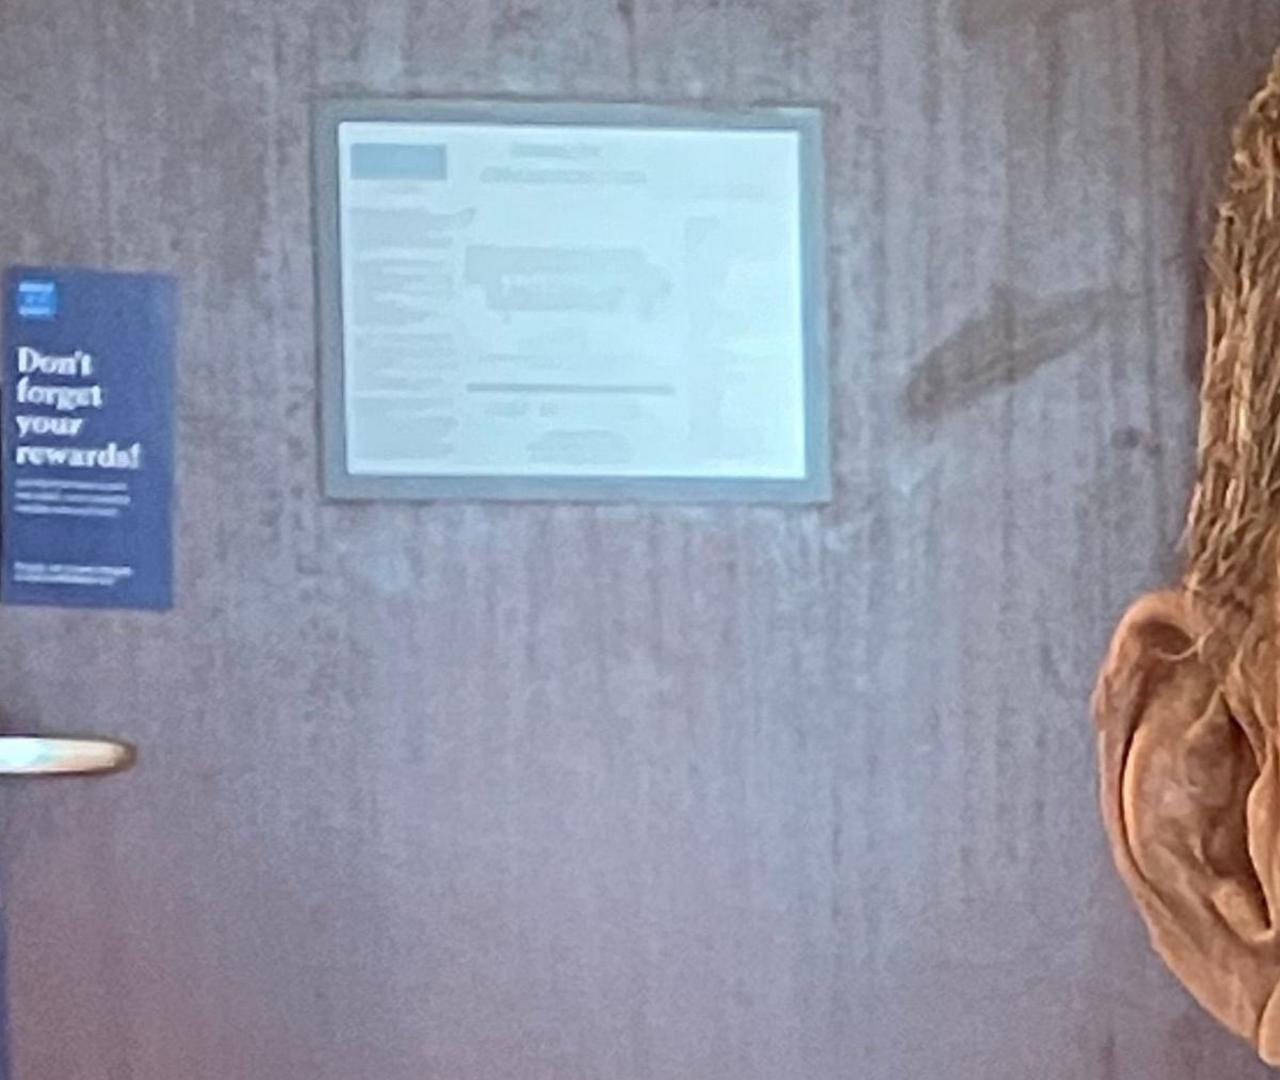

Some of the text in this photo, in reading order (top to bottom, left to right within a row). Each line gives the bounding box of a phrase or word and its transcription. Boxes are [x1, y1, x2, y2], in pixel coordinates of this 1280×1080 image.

[18, 346, 93, 376] Don't
[16, 377, 102, 410] forget
[15, 414, 84, 438] your
[15, 443, 141, 468] rewards!
